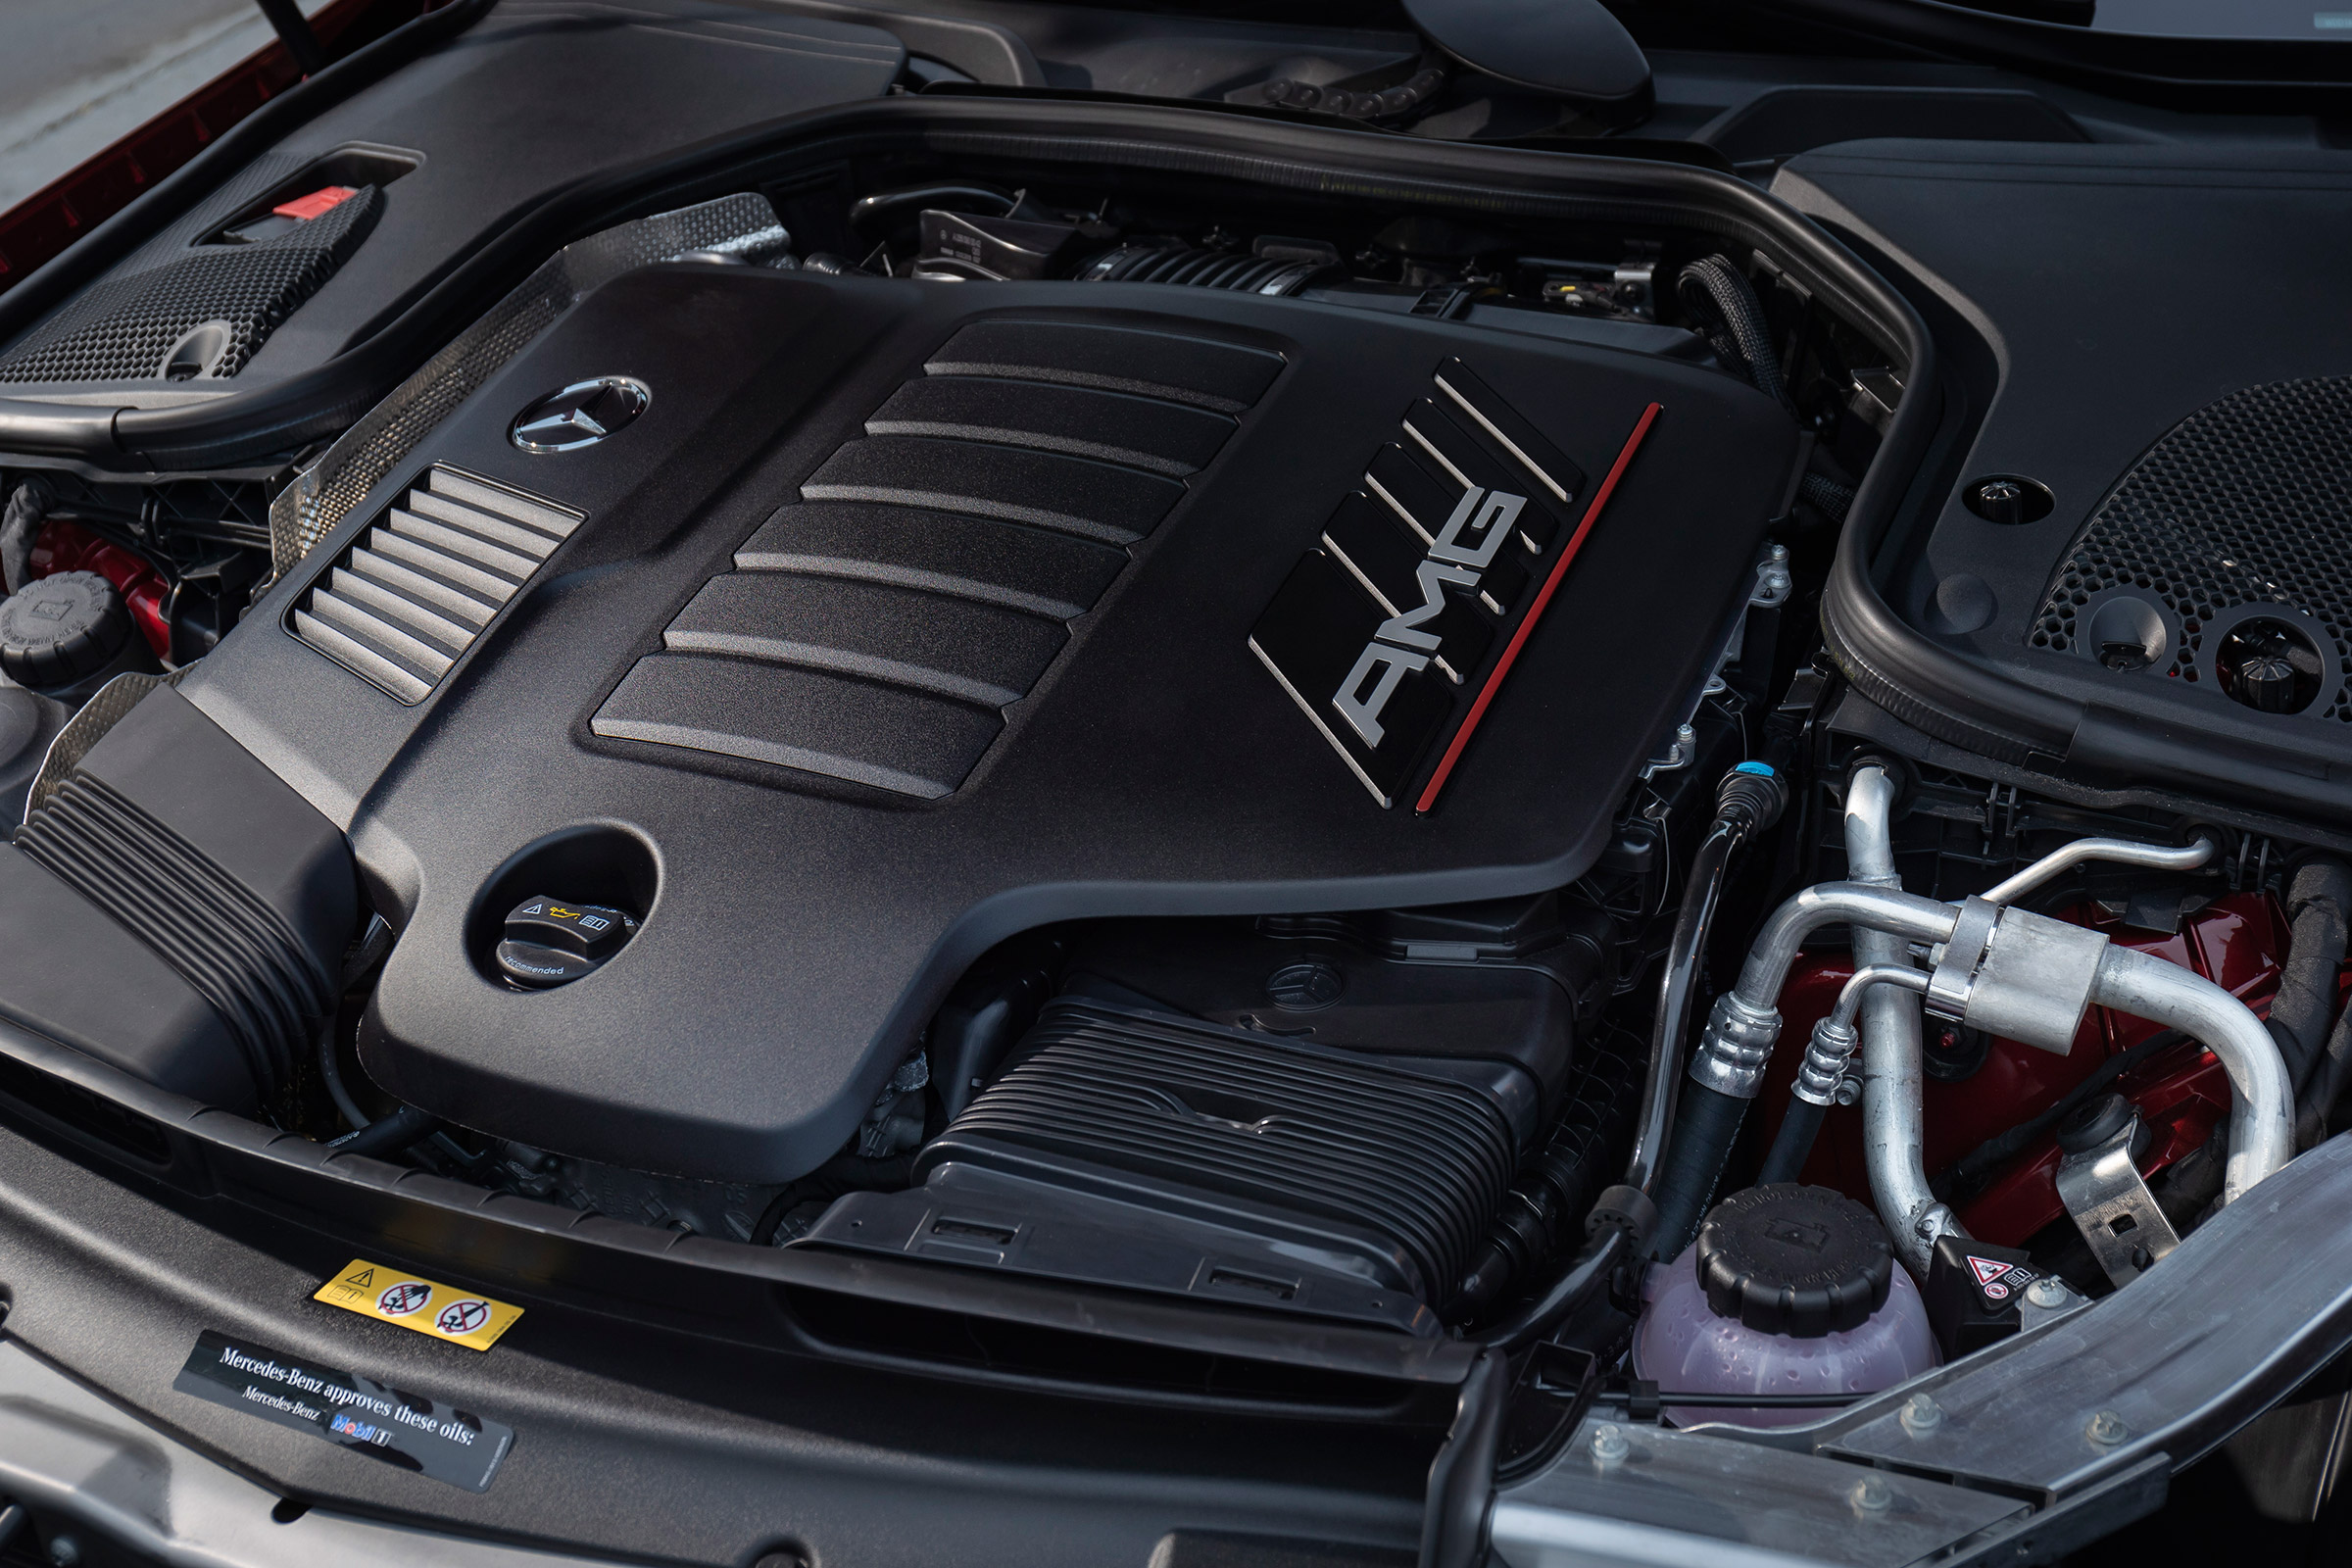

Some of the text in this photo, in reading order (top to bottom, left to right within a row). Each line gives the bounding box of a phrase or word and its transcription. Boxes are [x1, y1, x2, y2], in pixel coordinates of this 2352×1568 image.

[1332, 486, 1528, 749] AMG
[505, 956, 564, 975] recommended
[219, 1347, 475, 1446] Mercedes-Benz approves these oils:
[241, 1384, 321, 1422] Mercedes-Benz
[330, 1413, 377, 1442] Mobil
